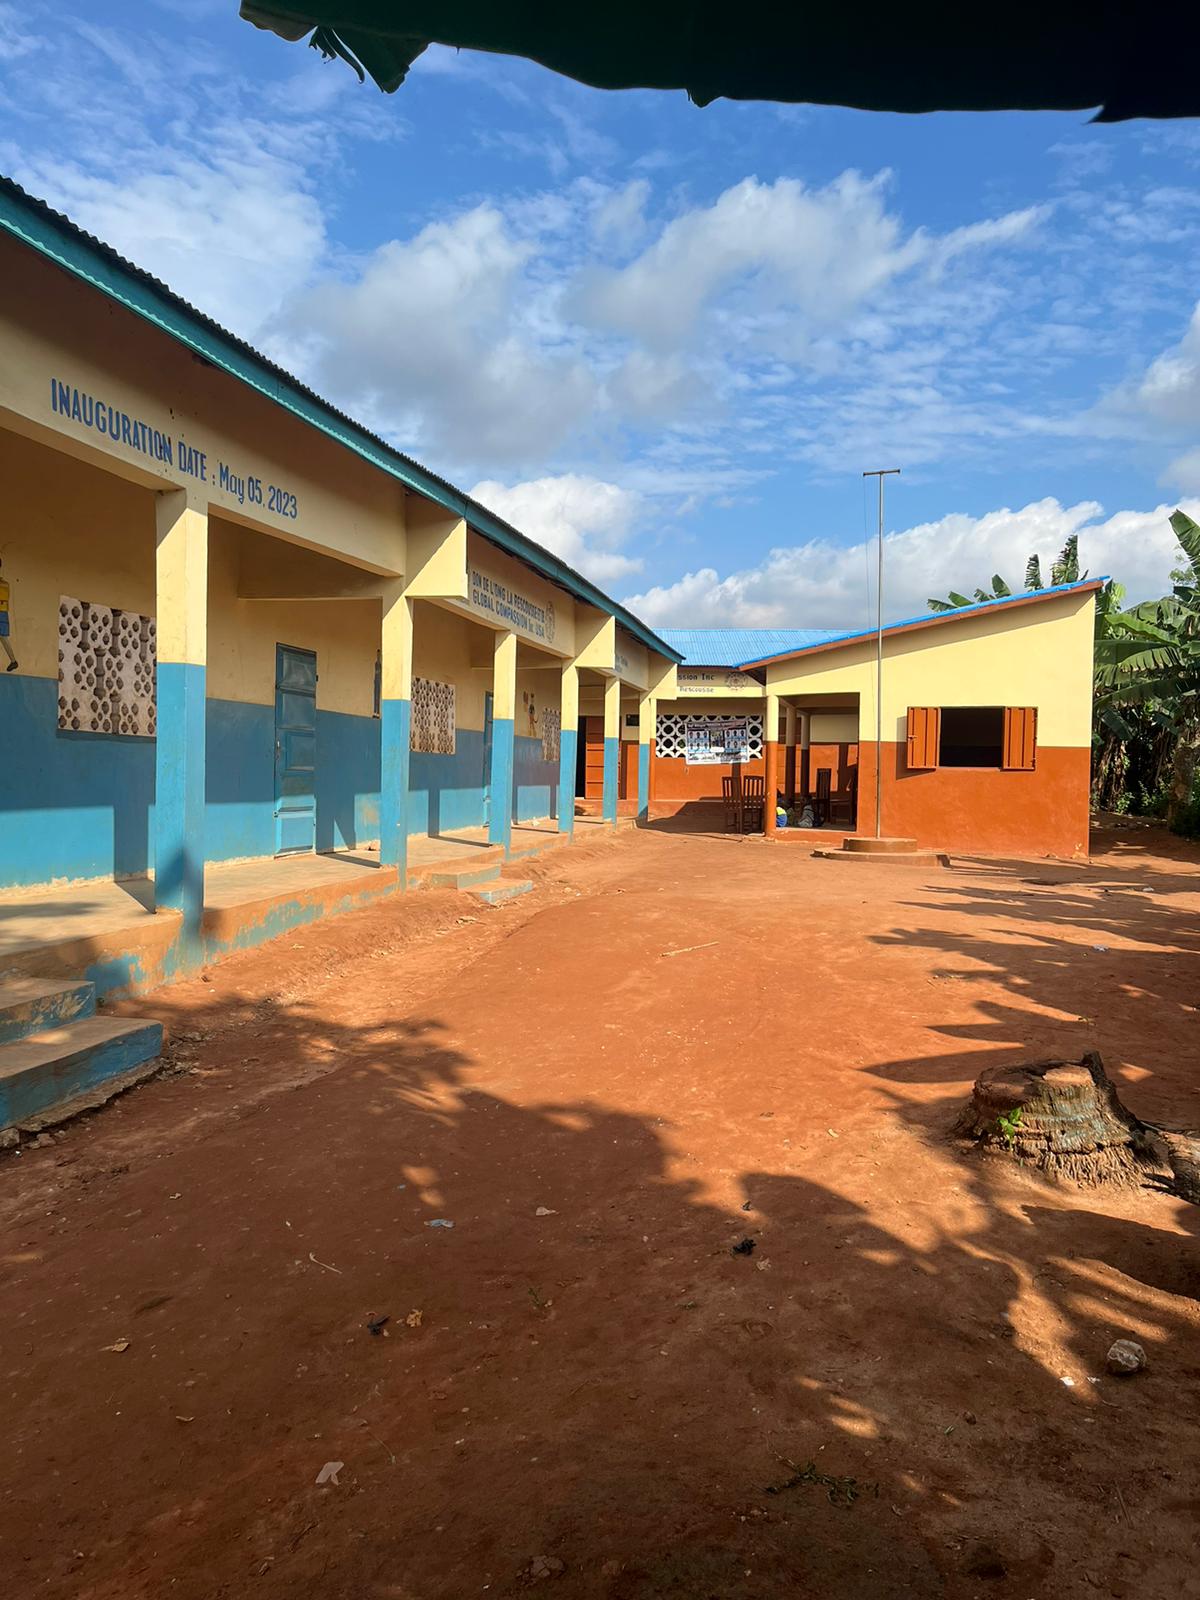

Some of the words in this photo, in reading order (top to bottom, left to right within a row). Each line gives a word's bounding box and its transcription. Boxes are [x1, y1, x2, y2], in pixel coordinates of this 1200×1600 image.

[51, 378, 173, 466] INAUGURATION
[178, 442, 207, 481] DATE
[218, 462, 245, 504] May
[268, 485, 297, 518] 2023
[483, 577, 489, 592] DE
[473, 590, 494, 611] GLOBAL
[496, 601, 527, 629] COMPASSION
[701, 672, 715, 681] Inc
